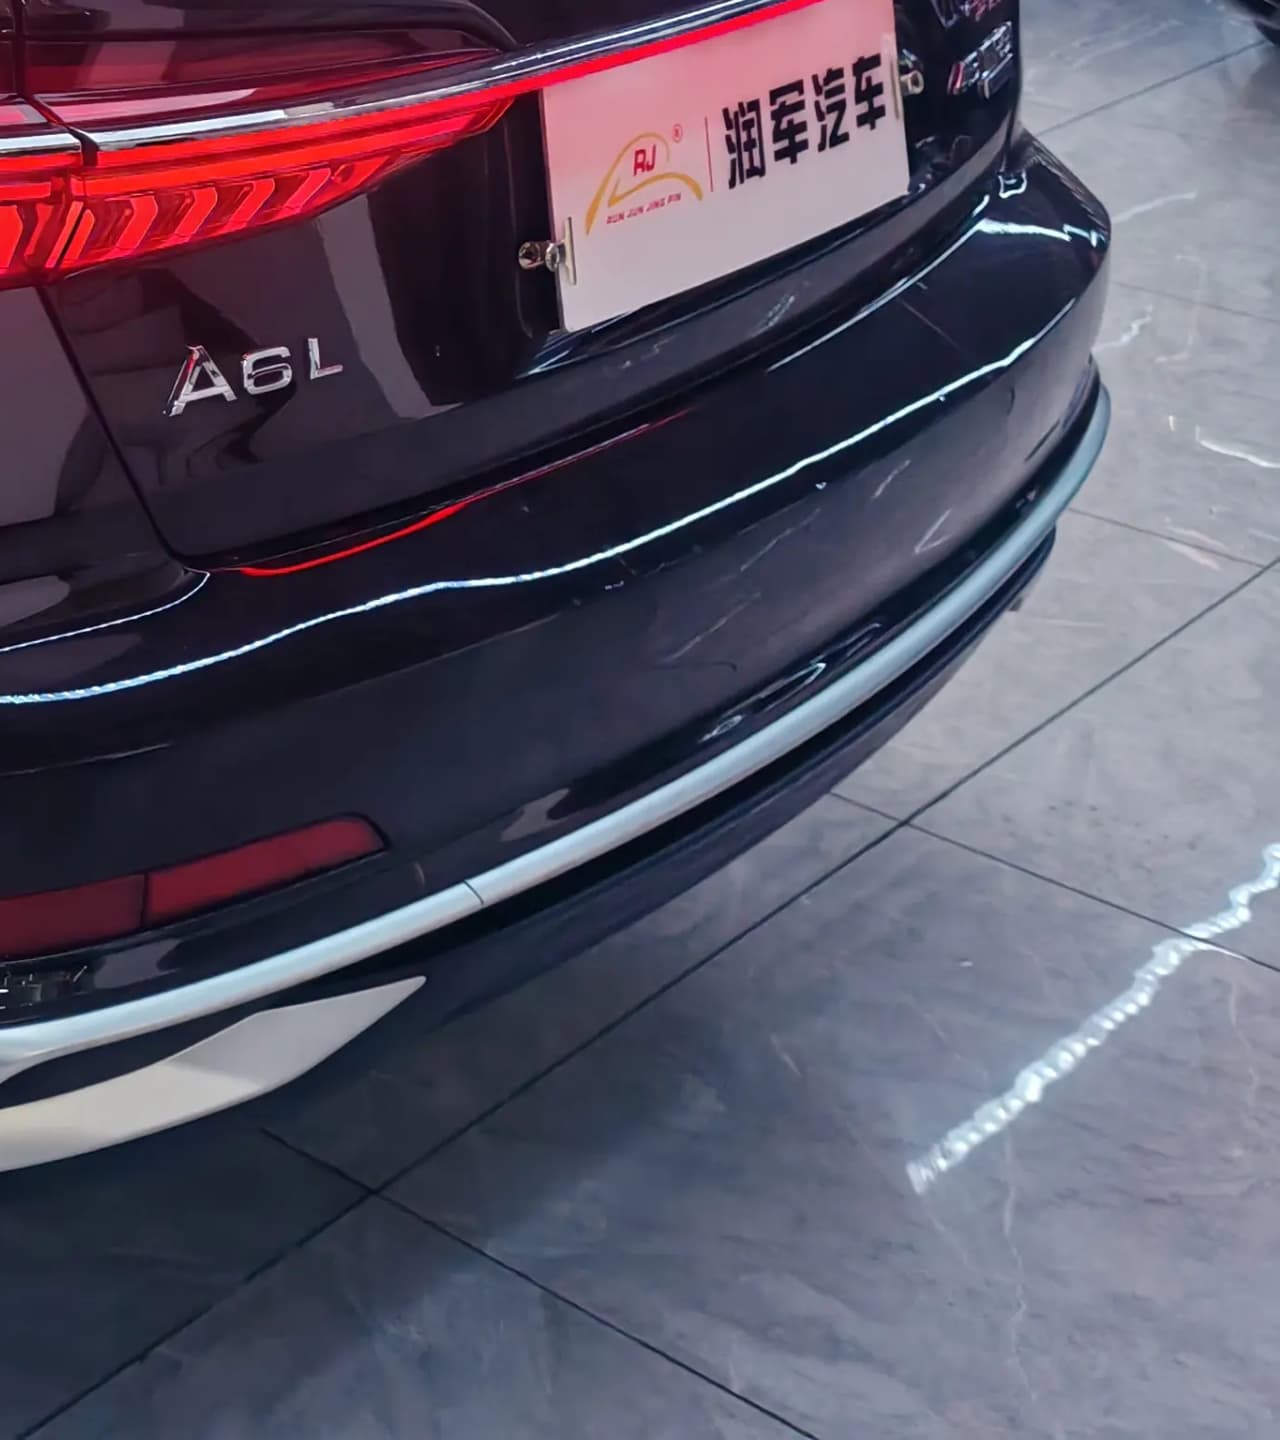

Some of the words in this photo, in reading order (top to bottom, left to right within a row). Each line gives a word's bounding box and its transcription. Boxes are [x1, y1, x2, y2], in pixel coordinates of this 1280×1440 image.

[722, 53, 886, 190] 润军汽车
[162, 337, 344, 417] A6L
